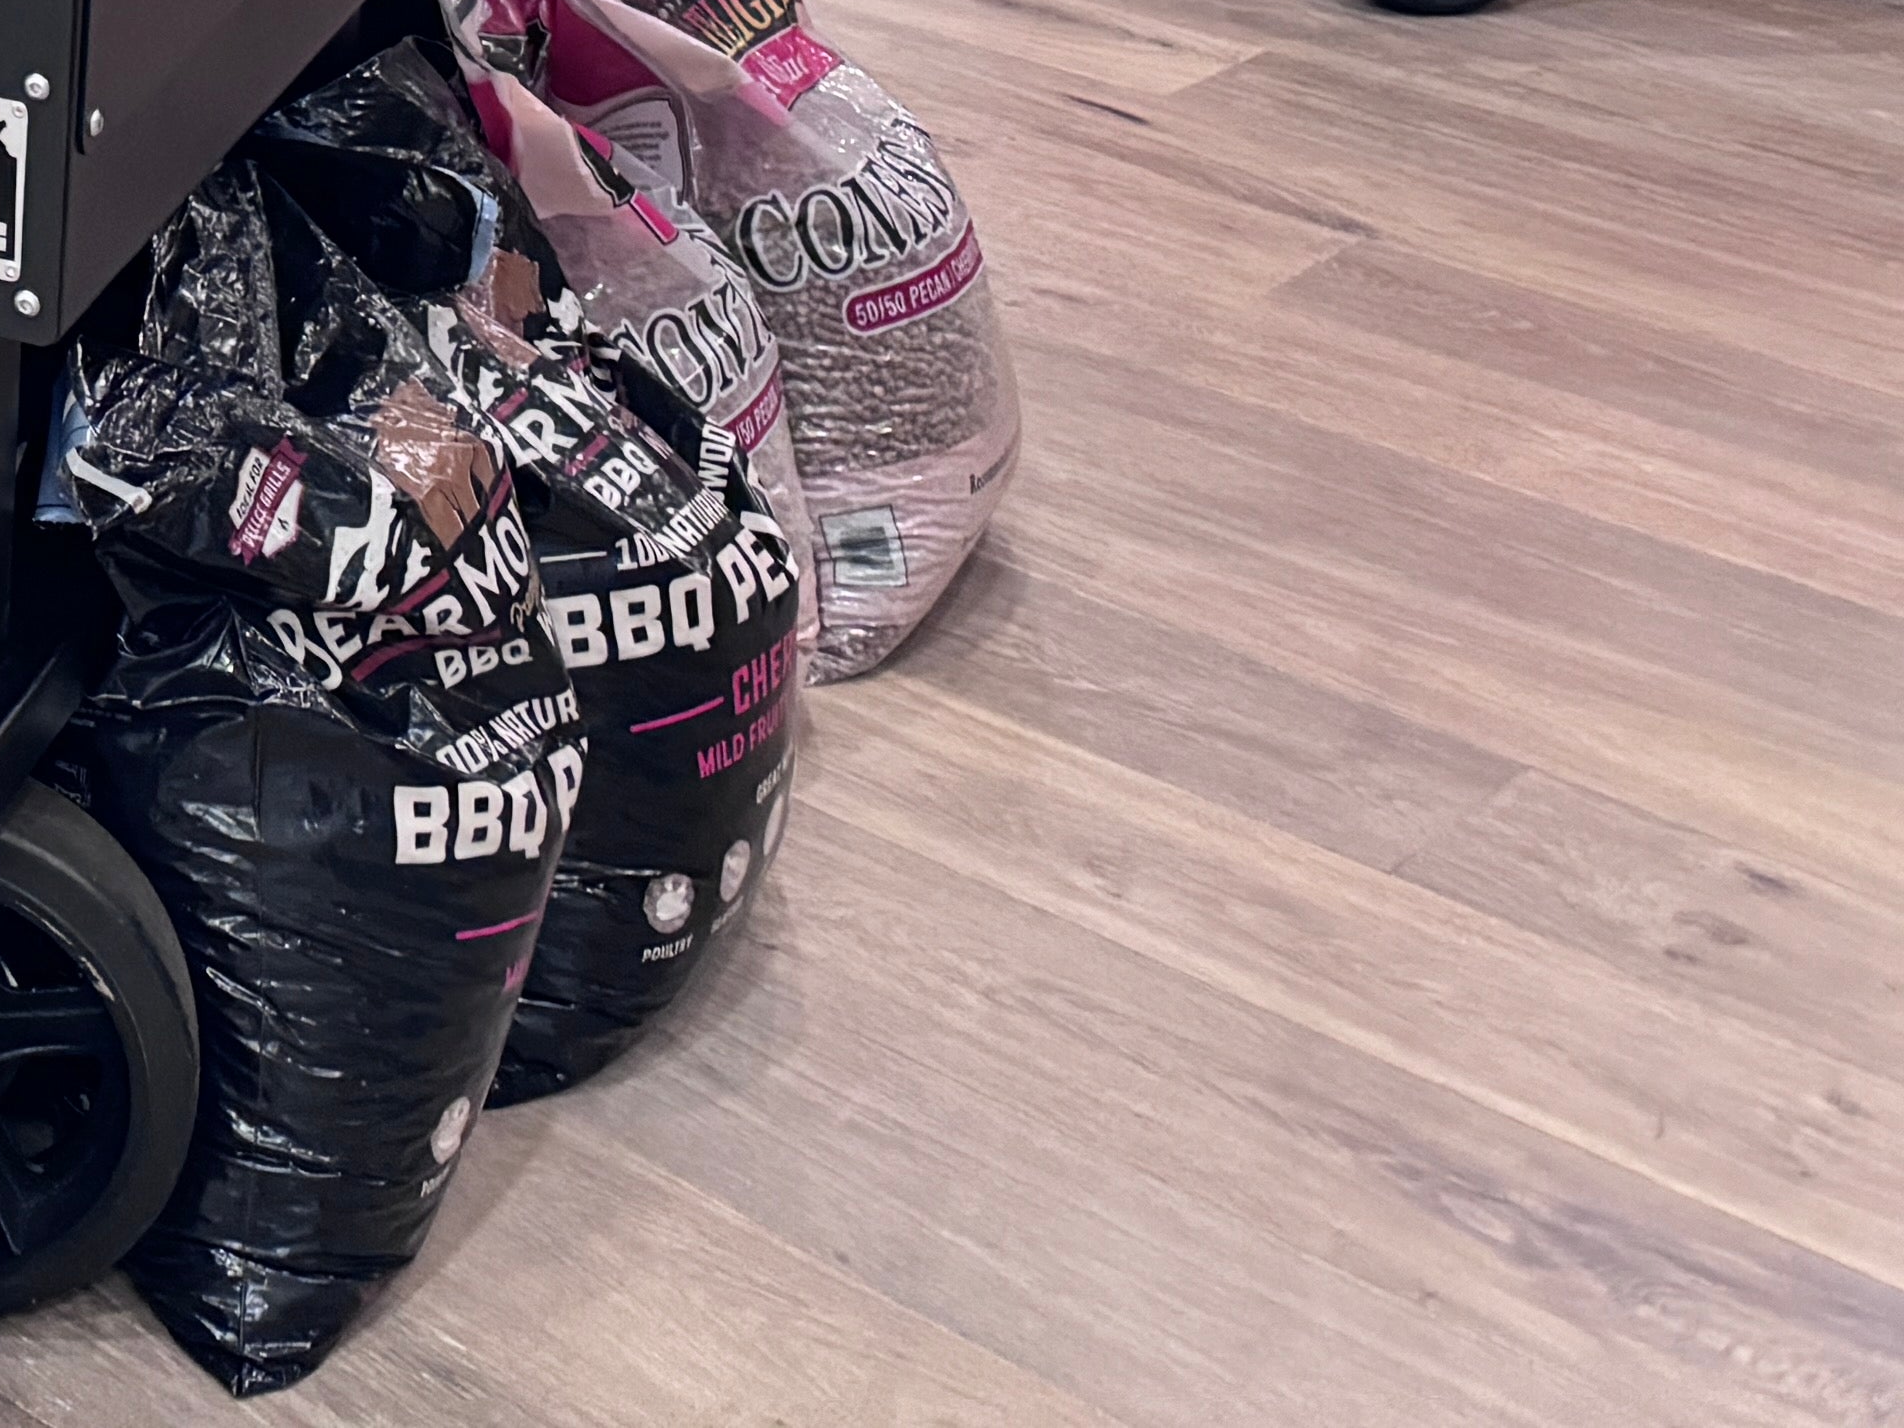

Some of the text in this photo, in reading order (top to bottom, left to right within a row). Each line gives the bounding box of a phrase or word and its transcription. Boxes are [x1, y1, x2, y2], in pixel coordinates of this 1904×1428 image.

[856, 292, 906, 327] 50/50
[584, 443, 659, 512] BBQ
[266, 593, 470, 691] BEAR
[540, 571, 716, 670] BBQ
[434, 640, 534, 690] BBQ
[697, 733, 747, 779] MILD
[393, 769, 548, 866] BBQ
